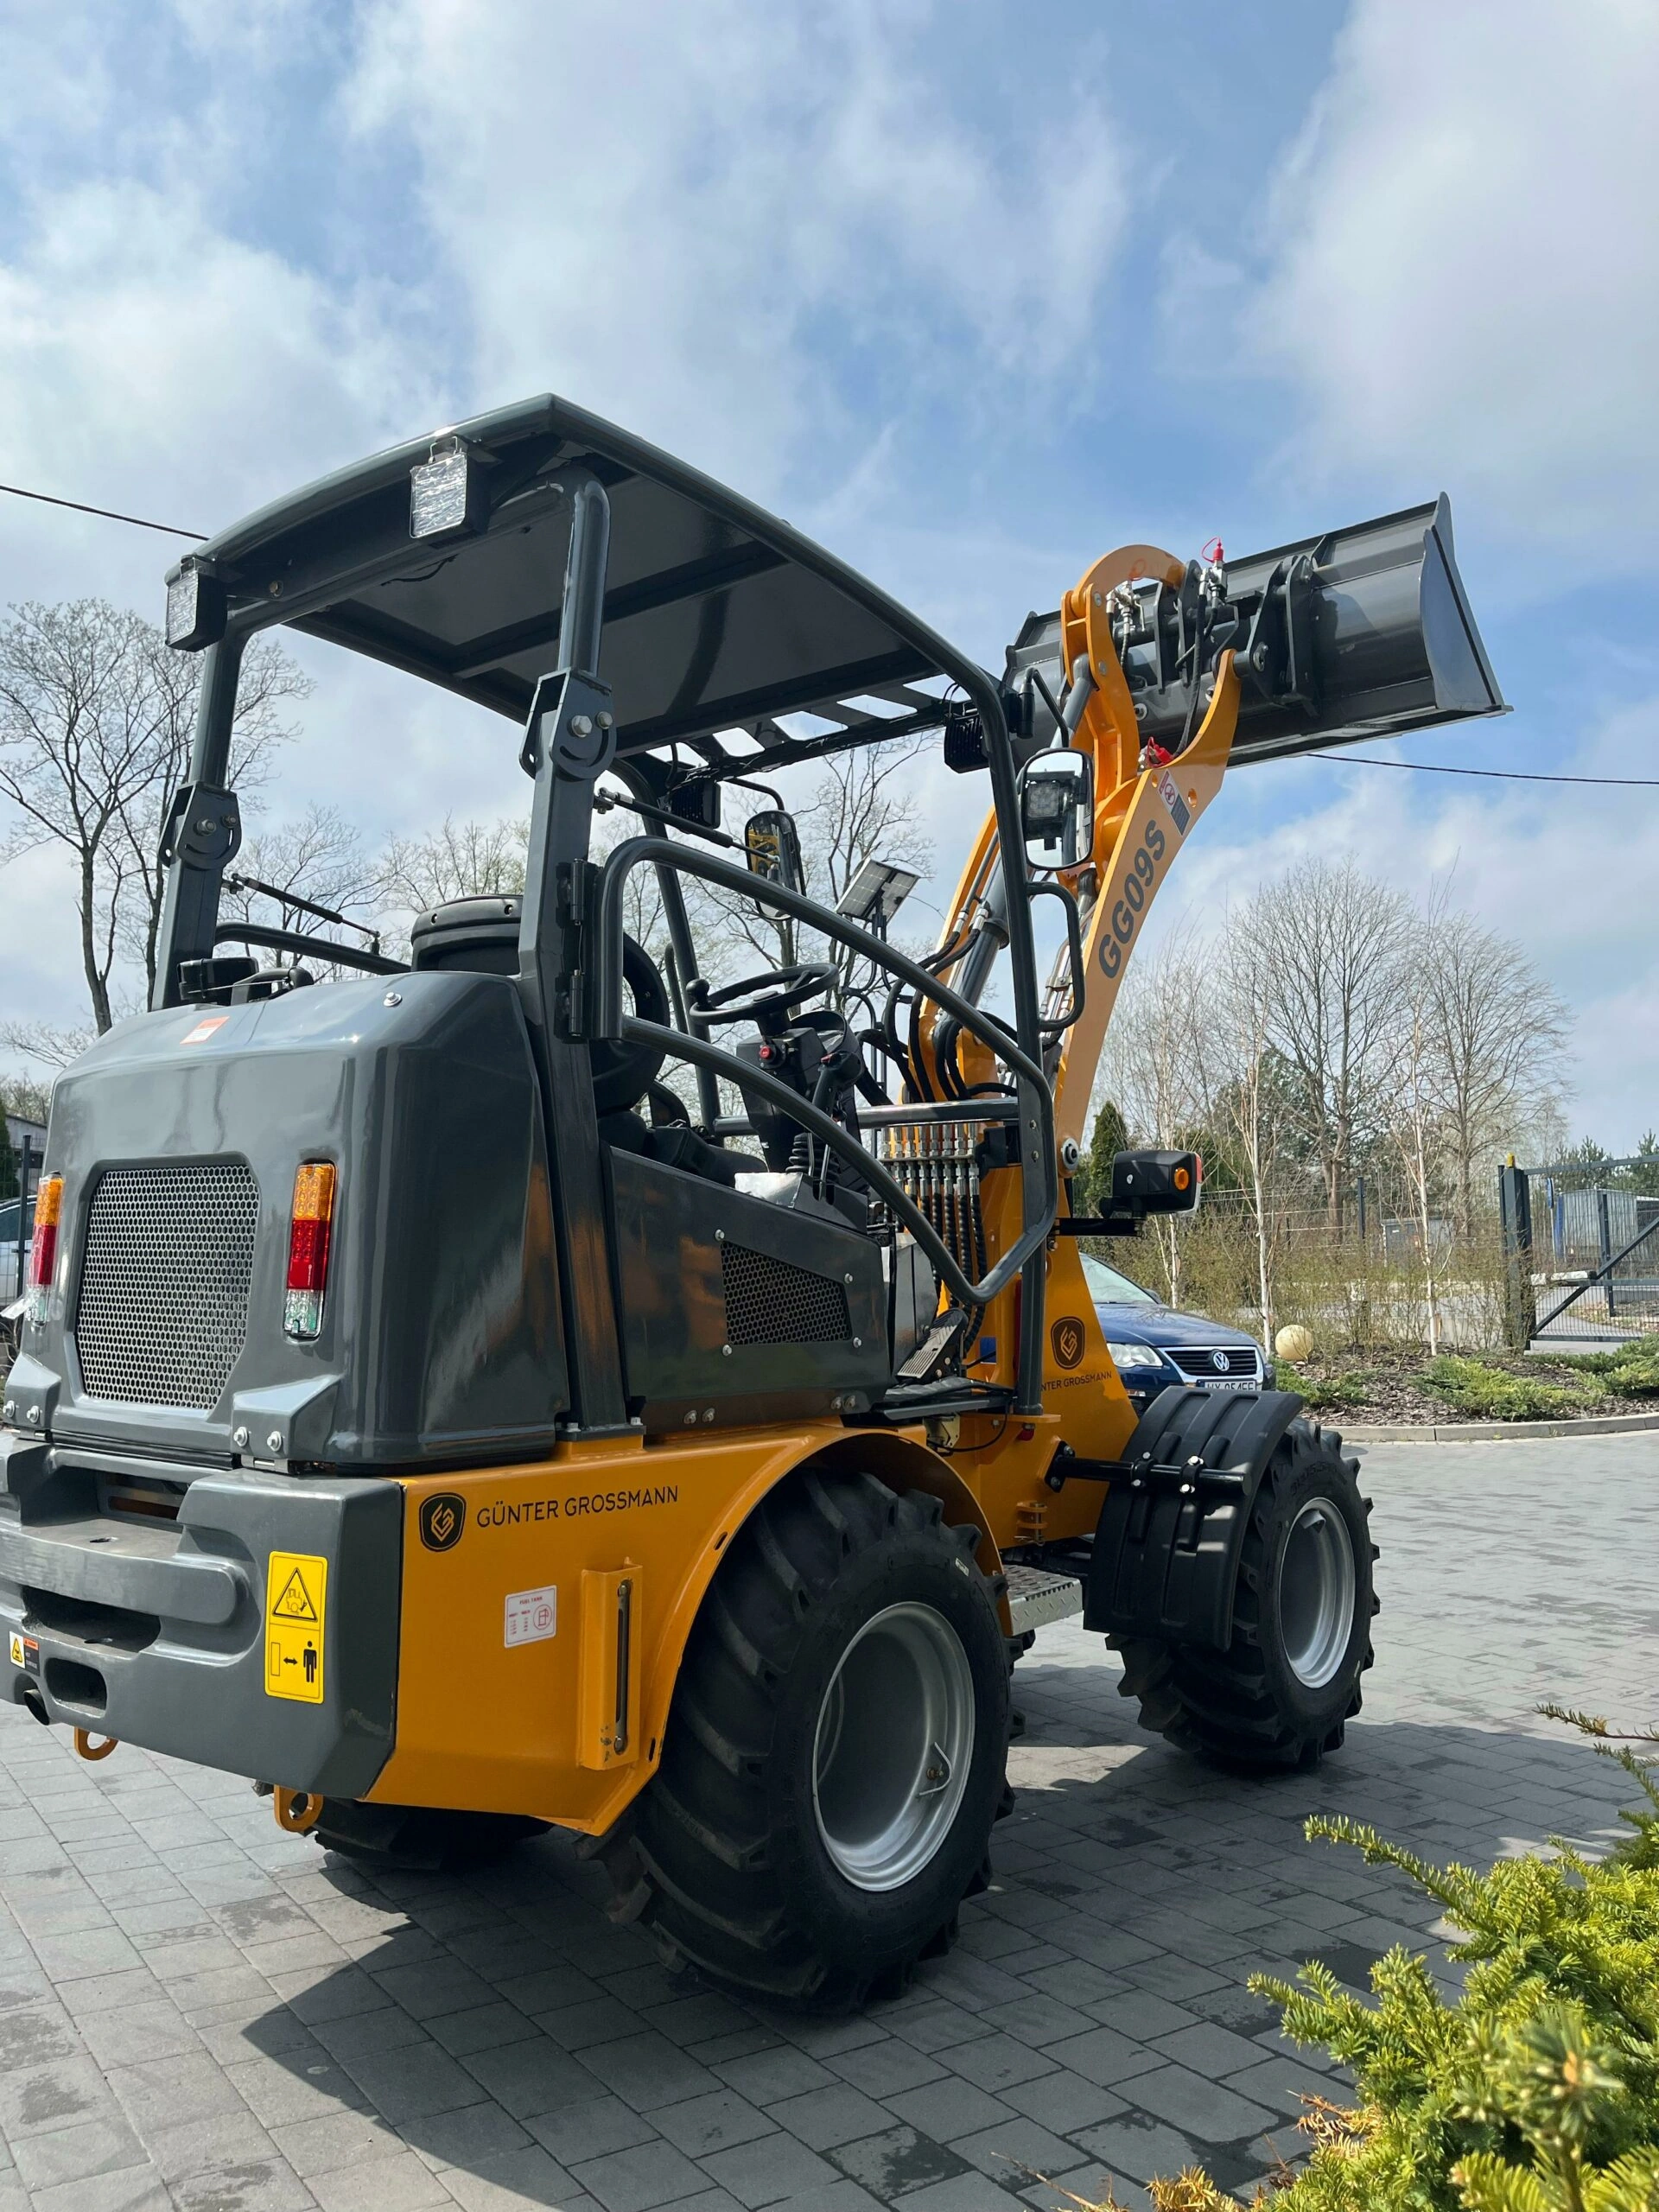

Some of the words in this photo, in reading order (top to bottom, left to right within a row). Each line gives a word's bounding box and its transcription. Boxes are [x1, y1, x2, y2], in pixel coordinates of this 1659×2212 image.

[1098, 819, 1166, 979] GG09S
[1041, 1380, 1062, 1391] NTER
[1064, 1371, 1112, 1387] GROSSMANN
[477, 1500, 559, 1528] GÜNTER
[564, 1484, 678, 1516] GROSSMANN
